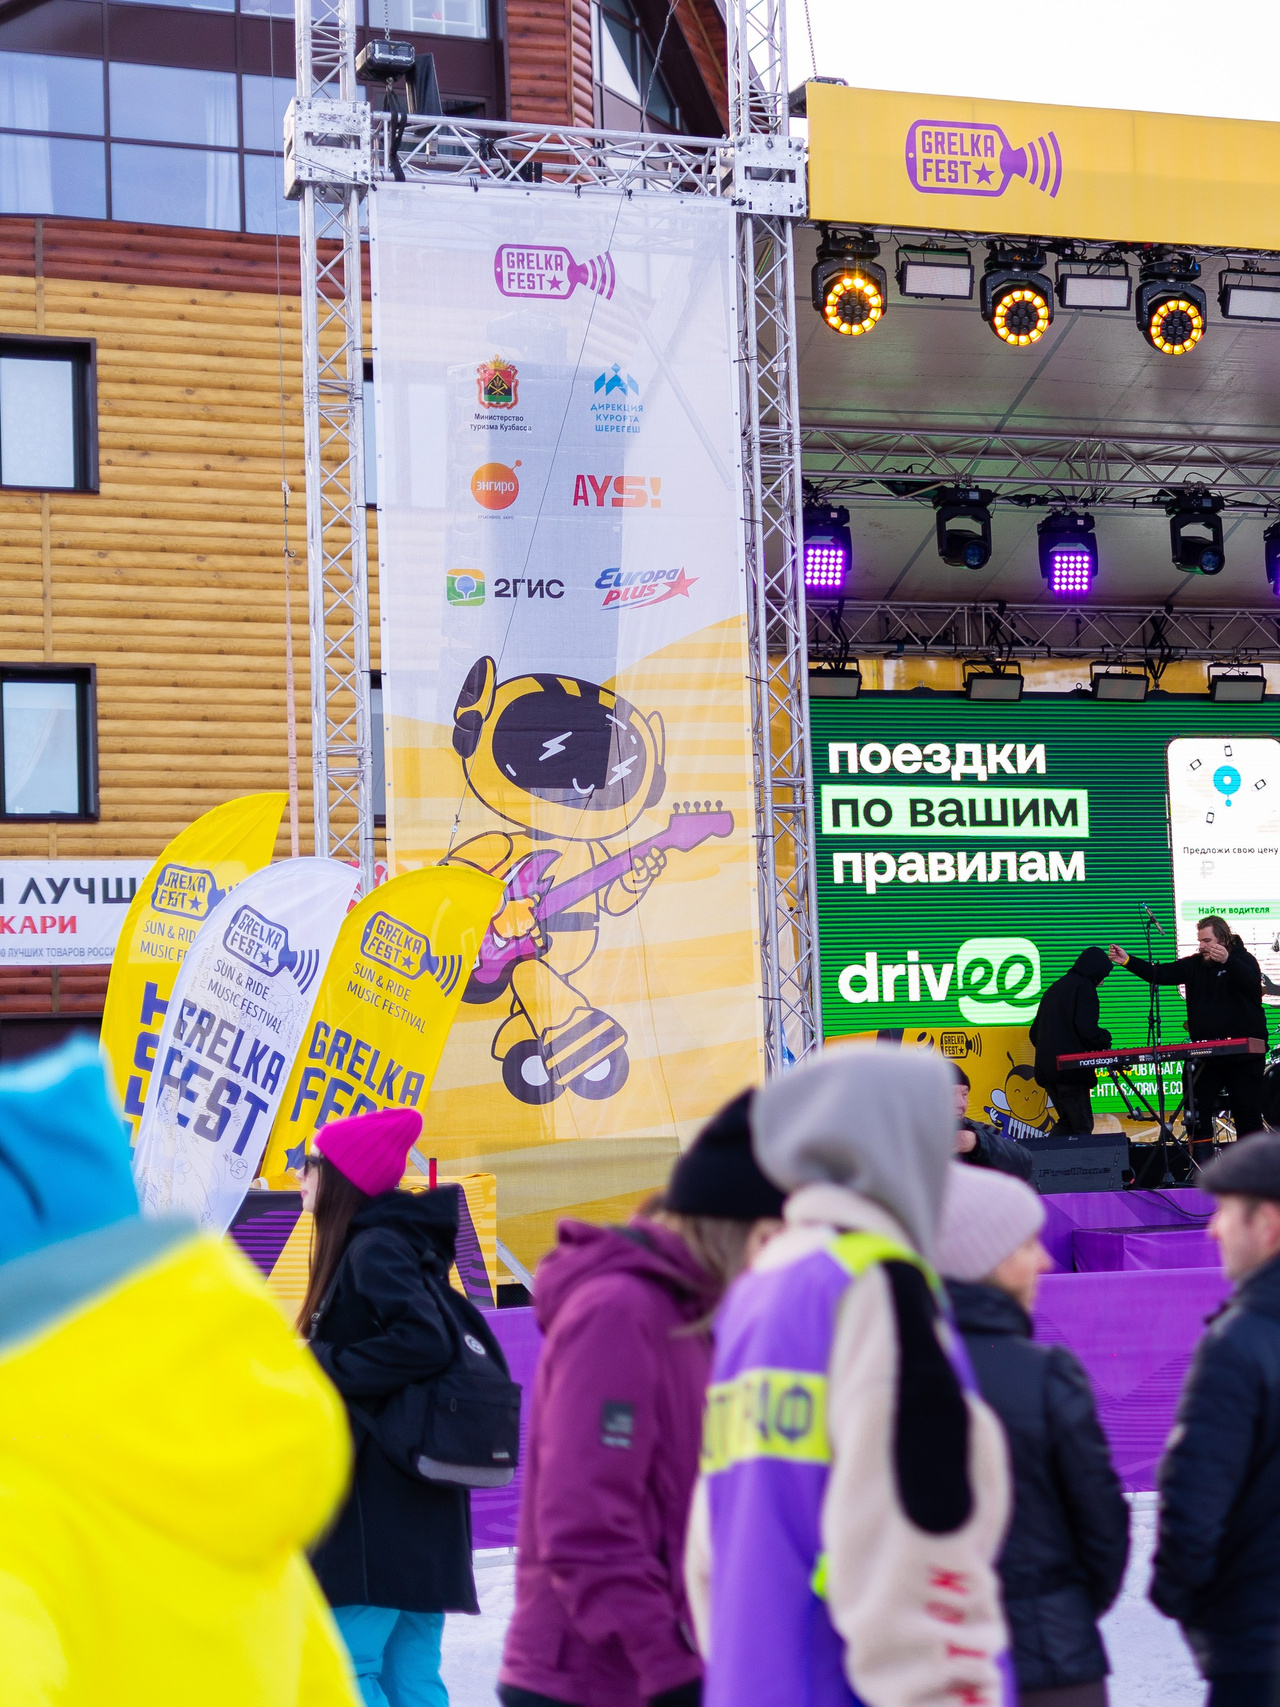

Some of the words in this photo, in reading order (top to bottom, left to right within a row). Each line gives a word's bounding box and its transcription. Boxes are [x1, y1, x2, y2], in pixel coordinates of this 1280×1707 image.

[921, 130, 995, 159] GRELKA
[922, 158, 972, 184] FEST
[506, 251, 564, 272] GRELKA
[507, 272, 546, 291] FEST
[474, 413, 524, 423] Министерство
[590, 403, 644, 413] ДИРЕКЦИЯ
[595, 413, 640, 423] КУРОРТА
[470, 423, 498, 432] туризма
[500, 423, 532, 432] Кузбасса
[595, 424, 641, 434] ШЕРЕГЕШ
[476, 480, 515, 494] энгиро
[573, 474, 662, 509] AYS!
[494, 578, 565, 599] 2ГИС
[828, 742, 1047, 781] поездки
[831, 798, 893, 828] по
[909, 798, 1079, 828] вашим
[1183, 846, 1230, 855] Предложи
[1257, 847, 1279, 855] цену
[832, 850, 1086, 894] правилам
[18, 877, 137, 905] ЛУЧШ
[1198, 906, 1227, 915] Найти
[1228, 906, 1270, 915] водителя
[143, 920, 165, 937] SUN
[167, 925, 175, 939] &
[178, 927, 197, 944] RID
[237, 912, 283, 951] GRELKA
[375, 918, 423, 953] GRELKA
[7, 947, 44, 958] ЛУЧШИХ
[46, 947, 86, 957] ТОВАРОВ
[88, 946, 116, 957] РОССИ
[140, 940, 175, 961] MUSIC
[230, 931, 263, 960] FEST
[367, 937, 402, 963] FEST
[214, 959, 236, 981] SUN
[235, 972, 244, 987] &
[245, 976, 270, 1001] RIDE
[352, 962, 377, 986] SUN
[376, 976, 384, 989] &
[385, 979, 411, 1002] RIDE
[838, 950, 1042, 1008] drivee
[207, 978, 241, 1008] MUSIC
[240, 997, 283, 1035] FESTIVAL
[346, 980, 380, 1010] MUSIC
[381, 998, 426, 1035] FESTIVAL
[172, 997, 286, 1096] GRELKA
[943, 1035, 965, 1045] GRELKA
[944, 1045, 959, 1055] FEST
[308, 1020, 425, 1107] GRELKA
[1080, 1058, 1096, 1066] nord
[156, 1045, 270, 1157] FEST
[289, 1066, 394, 1130] FE
